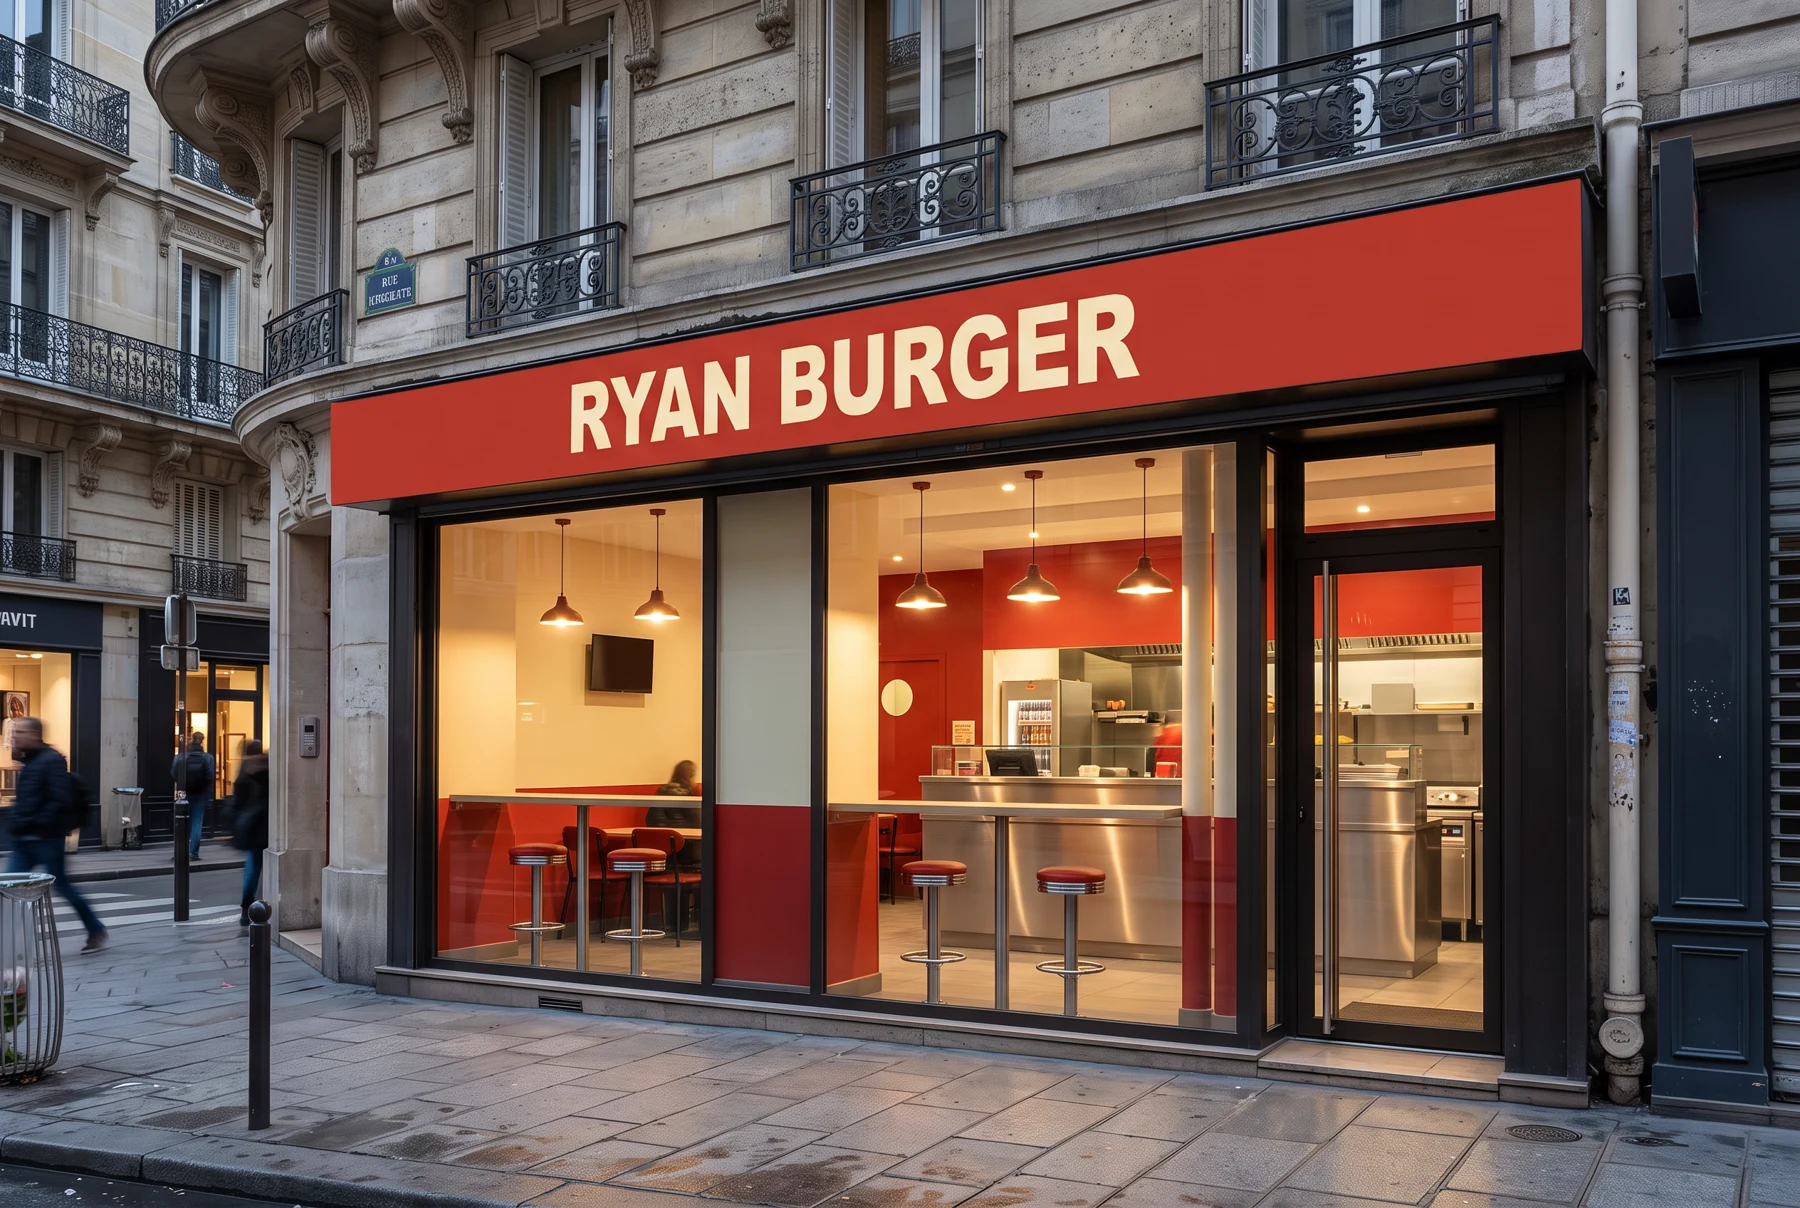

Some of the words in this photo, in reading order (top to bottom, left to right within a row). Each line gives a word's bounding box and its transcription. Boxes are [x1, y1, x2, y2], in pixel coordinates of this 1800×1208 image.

[382, 275, 398, 288] RUE
[570, 355, 751, 454] RYAN
[780, 293, 1141, 425] BURGER
[0, 611, 37, 629] AVIT
